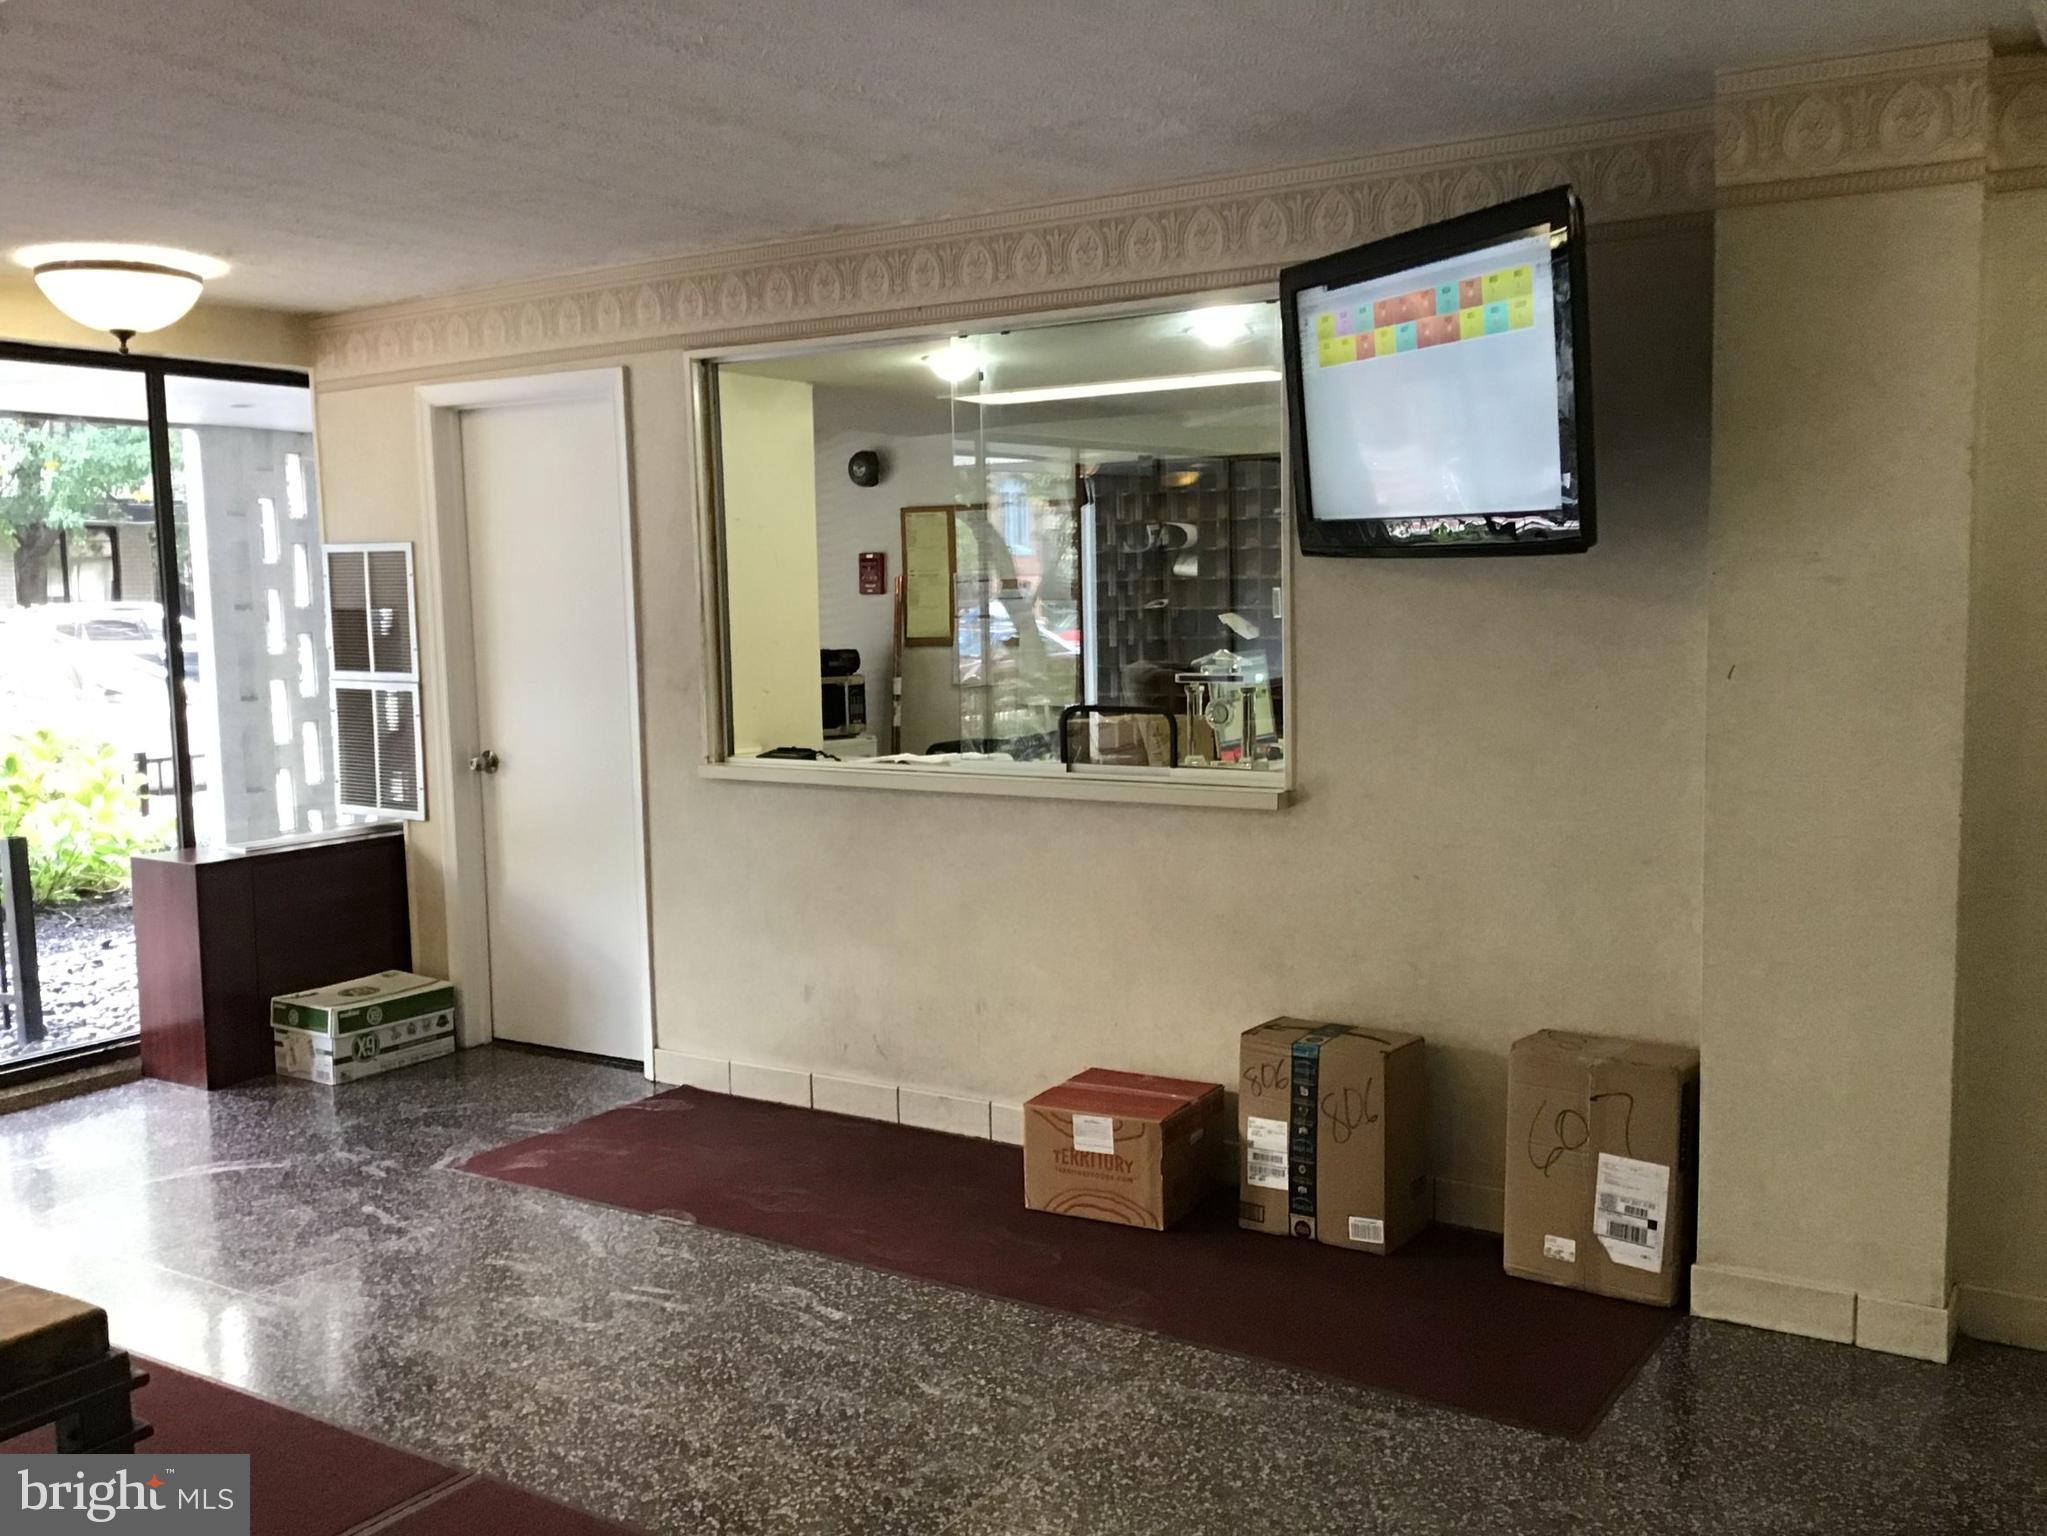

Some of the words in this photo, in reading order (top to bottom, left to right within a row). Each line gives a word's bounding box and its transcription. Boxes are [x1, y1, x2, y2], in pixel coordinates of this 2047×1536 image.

[1242, 1058, 1289, 1097] 806
[1320, 1077, 1378, 1144] 806
[1527, 1091, 1634, 1178] 607
[1053, 1149, 1135, 1174] TERRITORY
